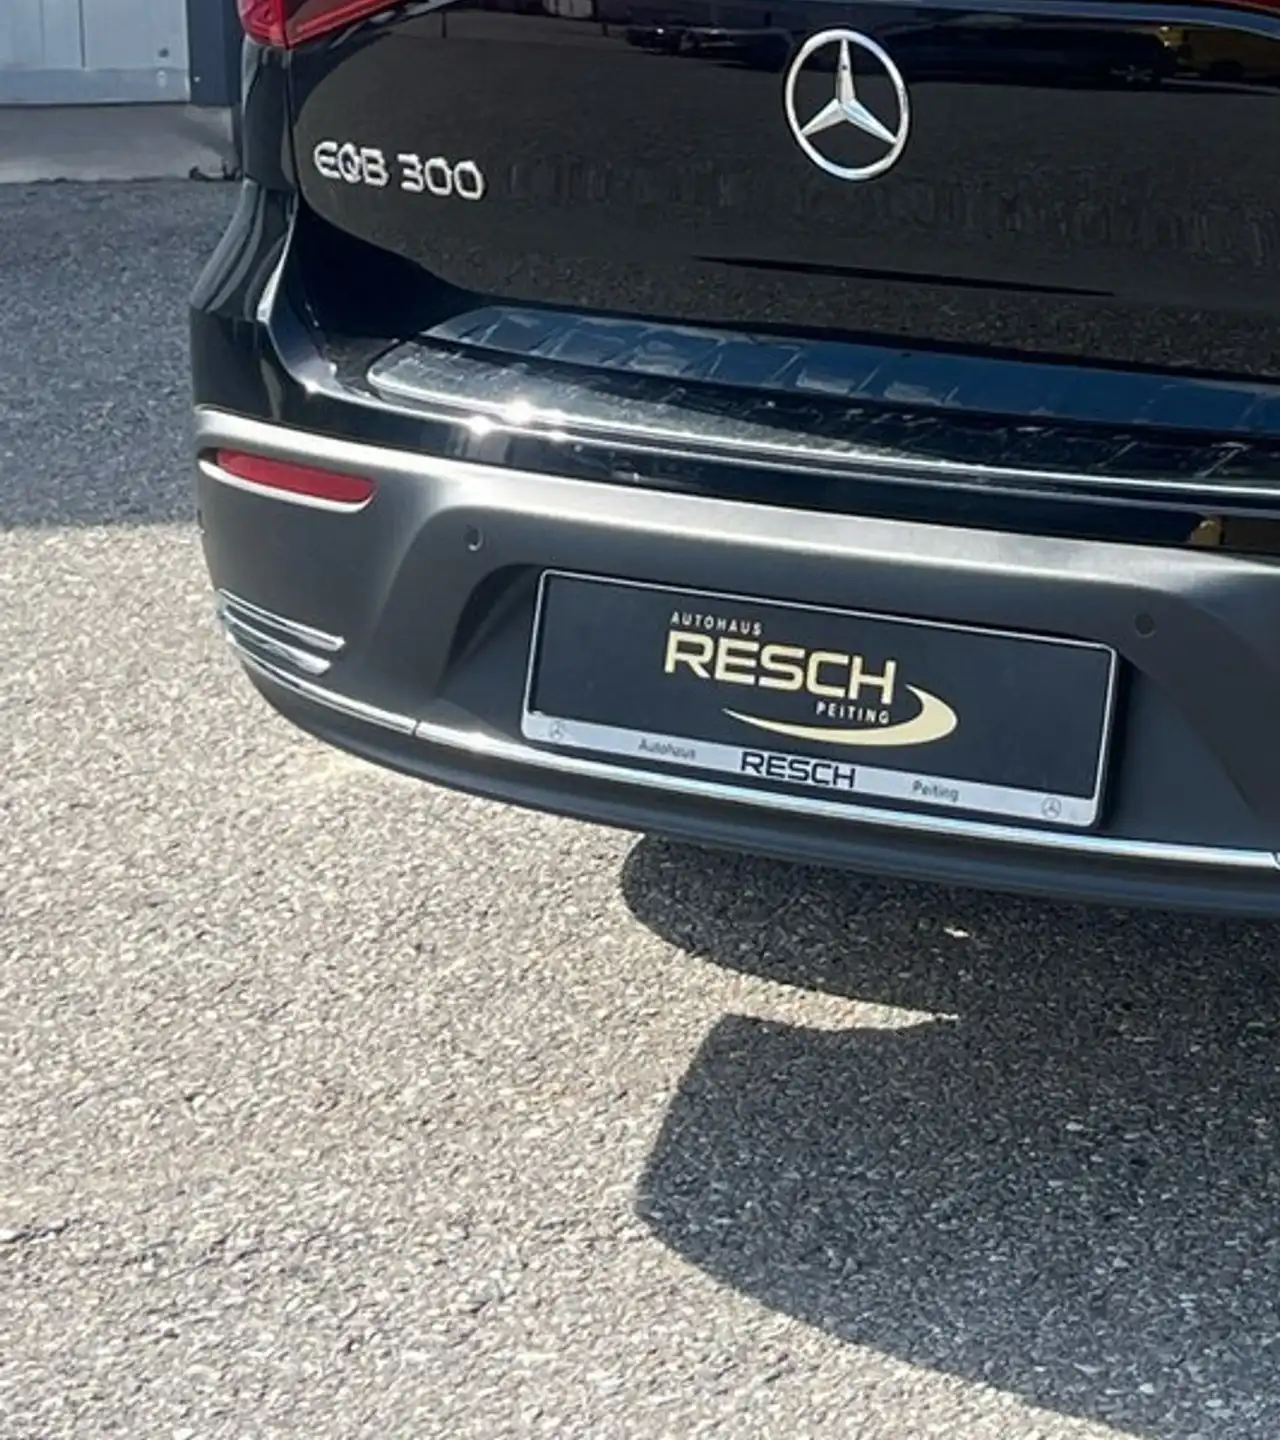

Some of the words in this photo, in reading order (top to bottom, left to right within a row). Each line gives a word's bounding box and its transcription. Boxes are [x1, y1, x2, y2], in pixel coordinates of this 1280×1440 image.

[314, 140, 389, 187] EQB
[397, 153, 486, 201] 300
[669, 610, 762, 636] AUTOHAUS
[664, 629, 897, 705] RESCH
[815, 700, 890, 725] PEITING
[637, 739, 697, 760] Autohaus
[739, 750, 857, 789] RESCH
[911, 779, 960, 803] Peiting
